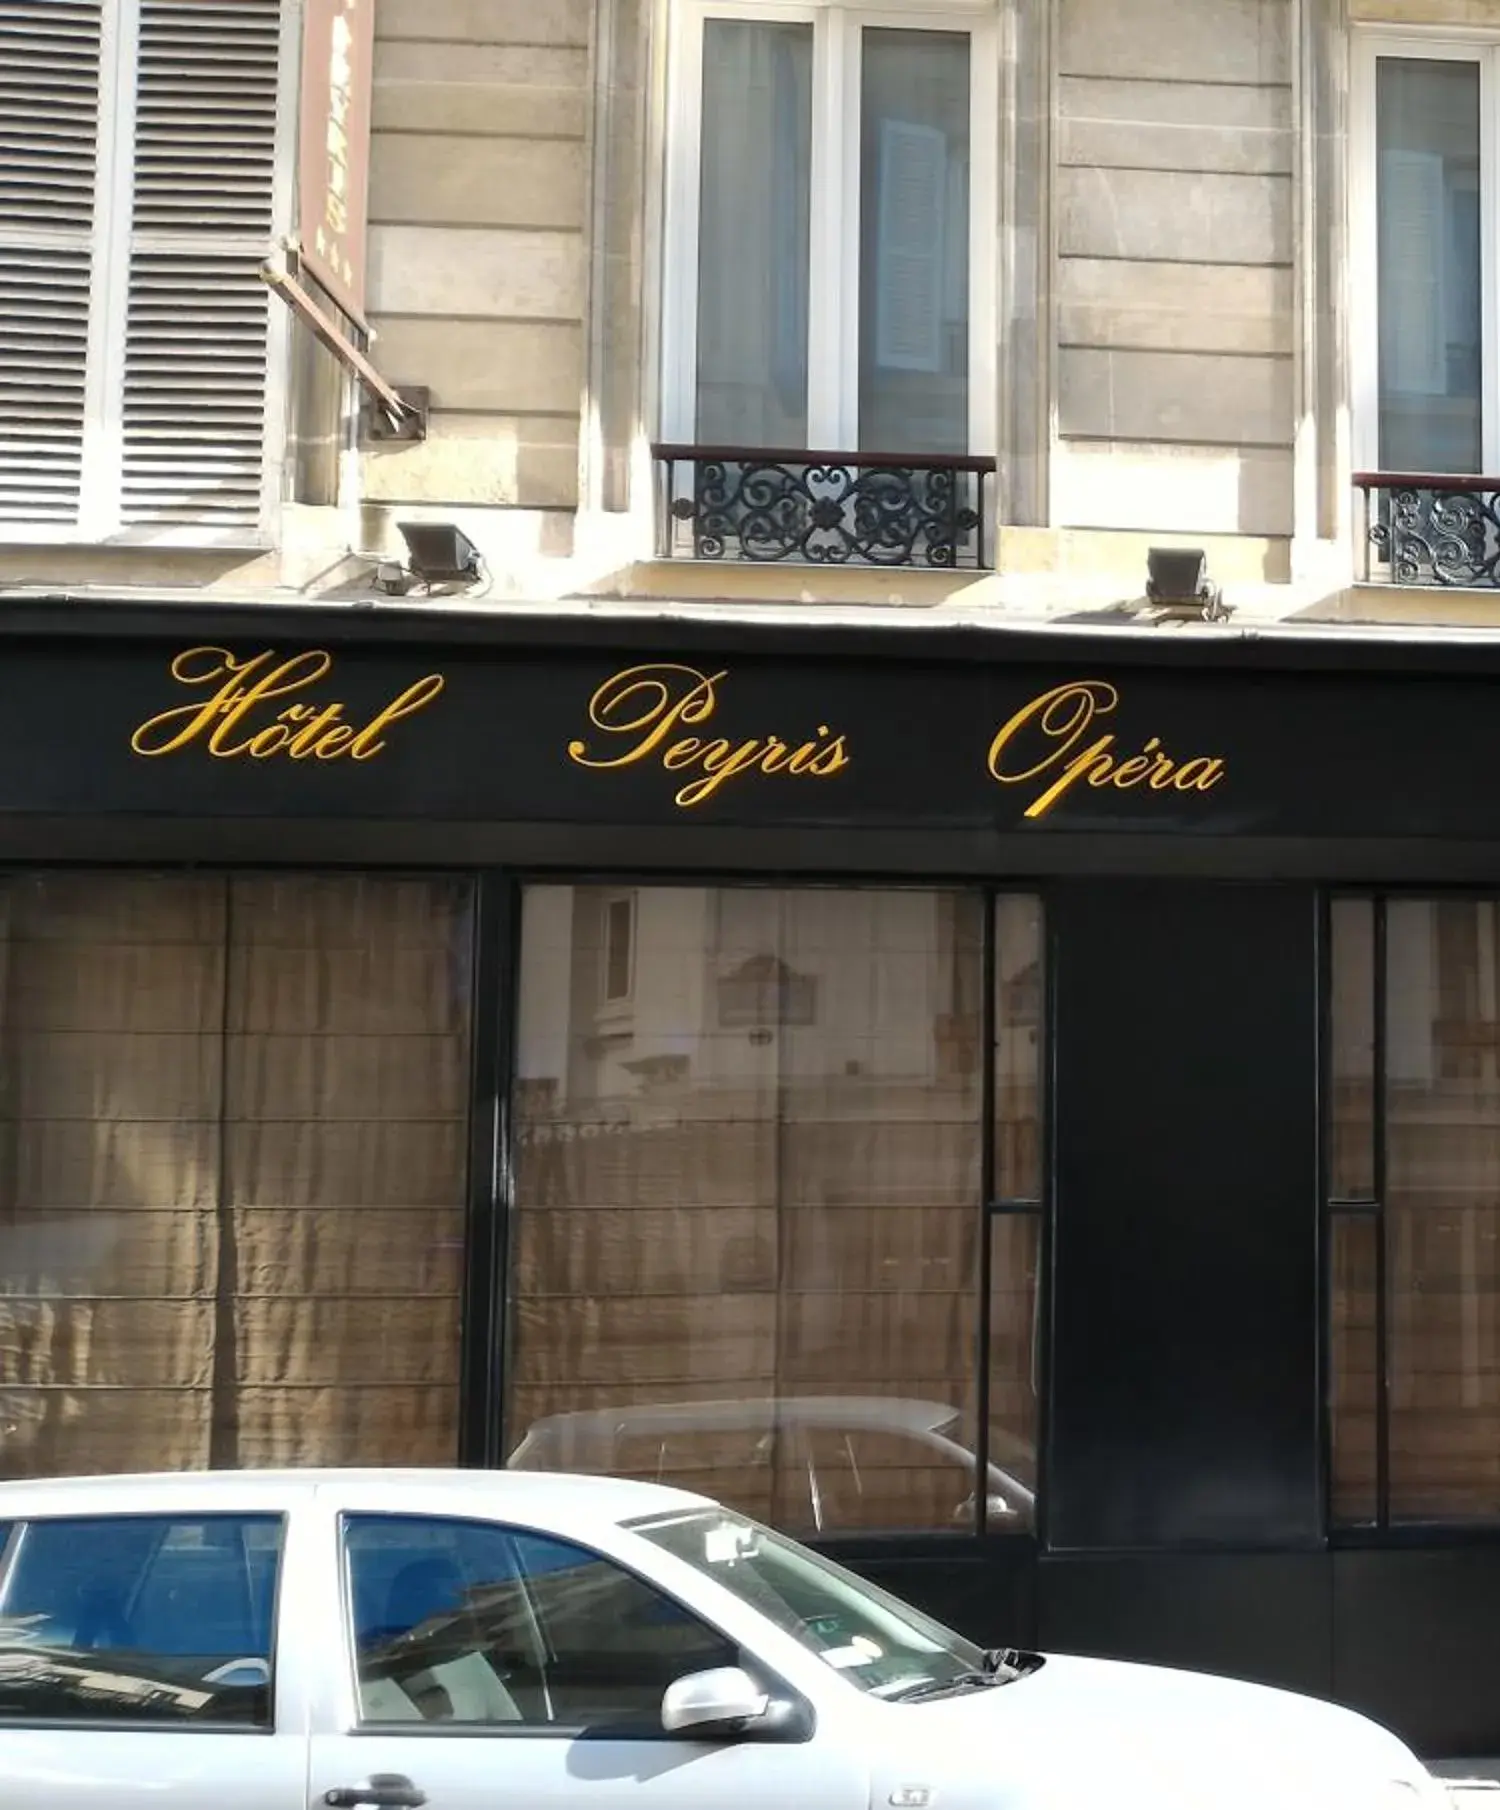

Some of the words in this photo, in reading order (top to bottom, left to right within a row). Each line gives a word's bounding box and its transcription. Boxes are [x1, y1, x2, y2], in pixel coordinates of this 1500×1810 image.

[131, 646, 445, 760] Hôtel
[567, 664, 849, 807] Peyris
[987, 681, 1225, 818] Opéra
